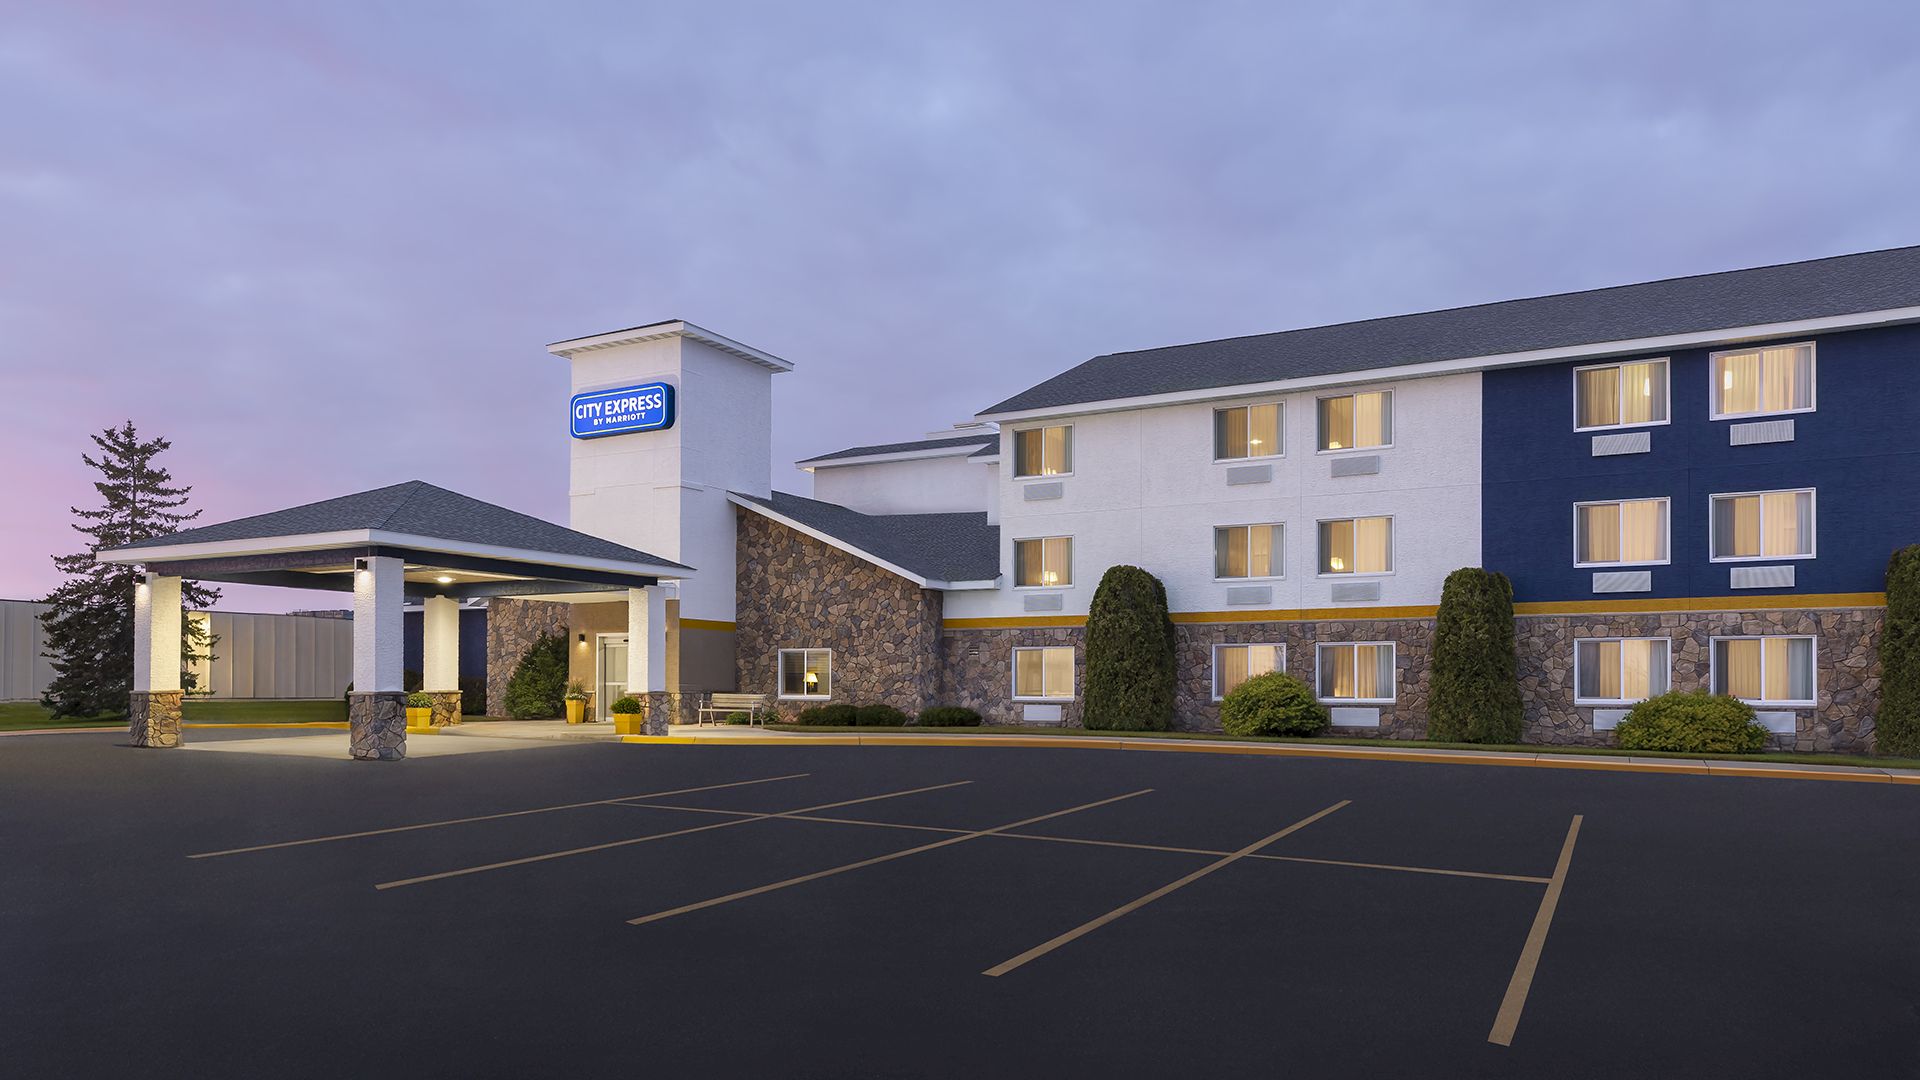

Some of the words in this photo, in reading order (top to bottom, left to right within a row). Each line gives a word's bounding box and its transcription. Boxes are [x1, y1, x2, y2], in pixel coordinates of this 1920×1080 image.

[575, 402, 602, 419] CITY
[605, 393, 662, 415] EXPRESS
[593, 418, 603, 426] BY
[606, 412, 646, 424] MARRIOTT
